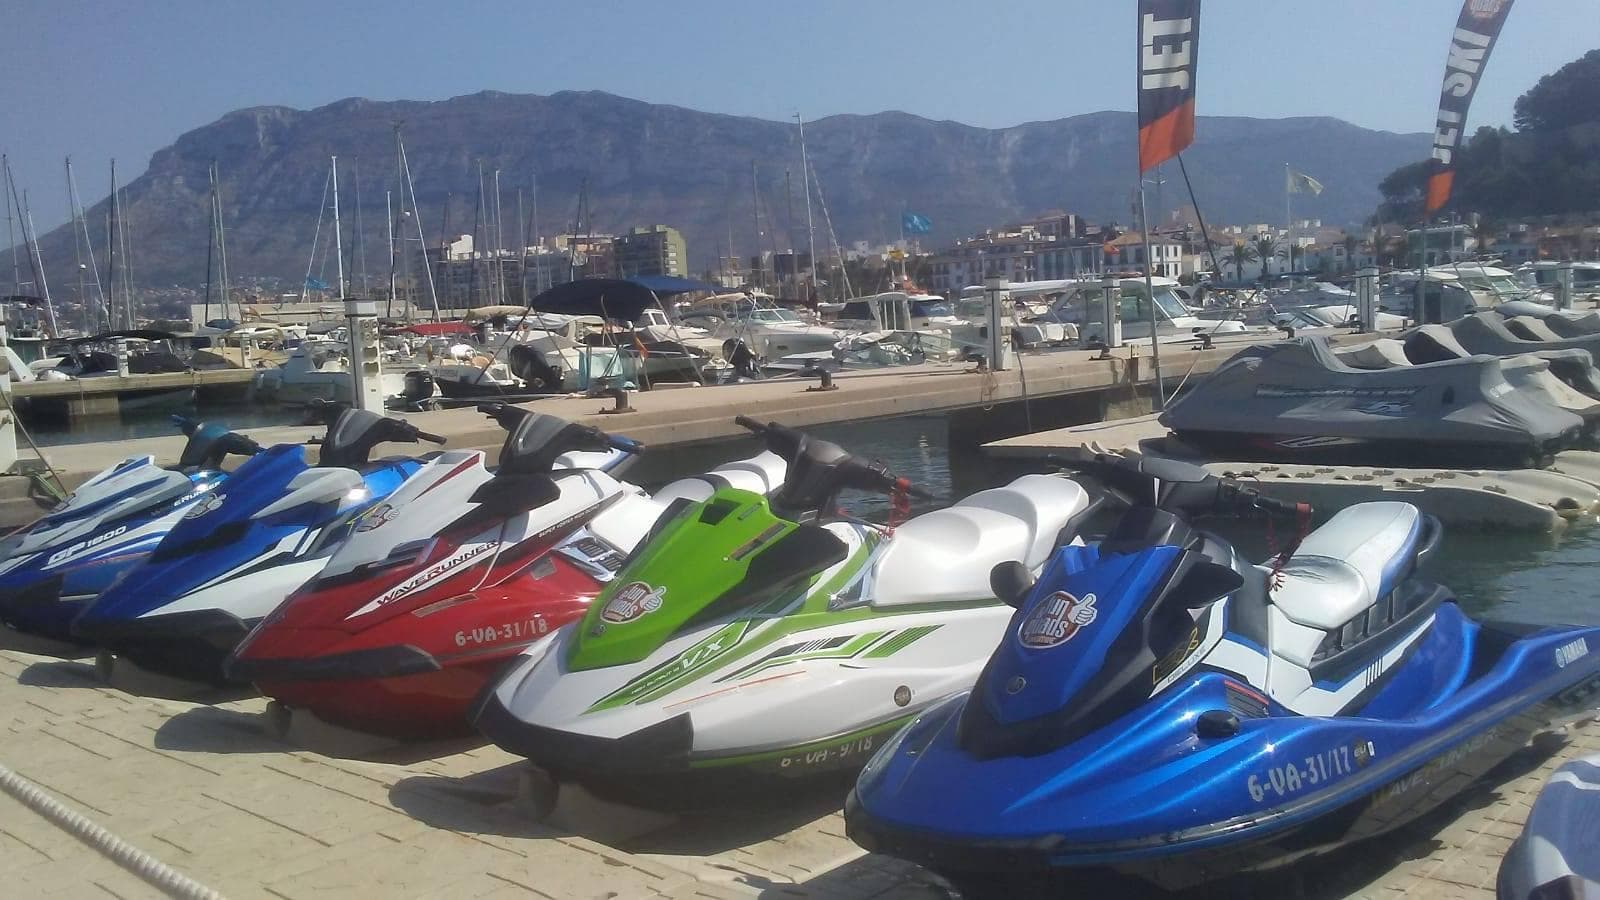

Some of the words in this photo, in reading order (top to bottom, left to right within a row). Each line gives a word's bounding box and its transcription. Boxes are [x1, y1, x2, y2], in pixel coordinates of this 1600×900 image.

[1142, 13, 1192, 90] JET
[1443, 27, 1492, 97] SKI
[1432, 109, 1462, 164] JET
[376, 541, 500, 605] WAVERUNNER
[682, 636, 725, 669] VX
[1247, 746, 1351, 802] 6-VA-31/17
